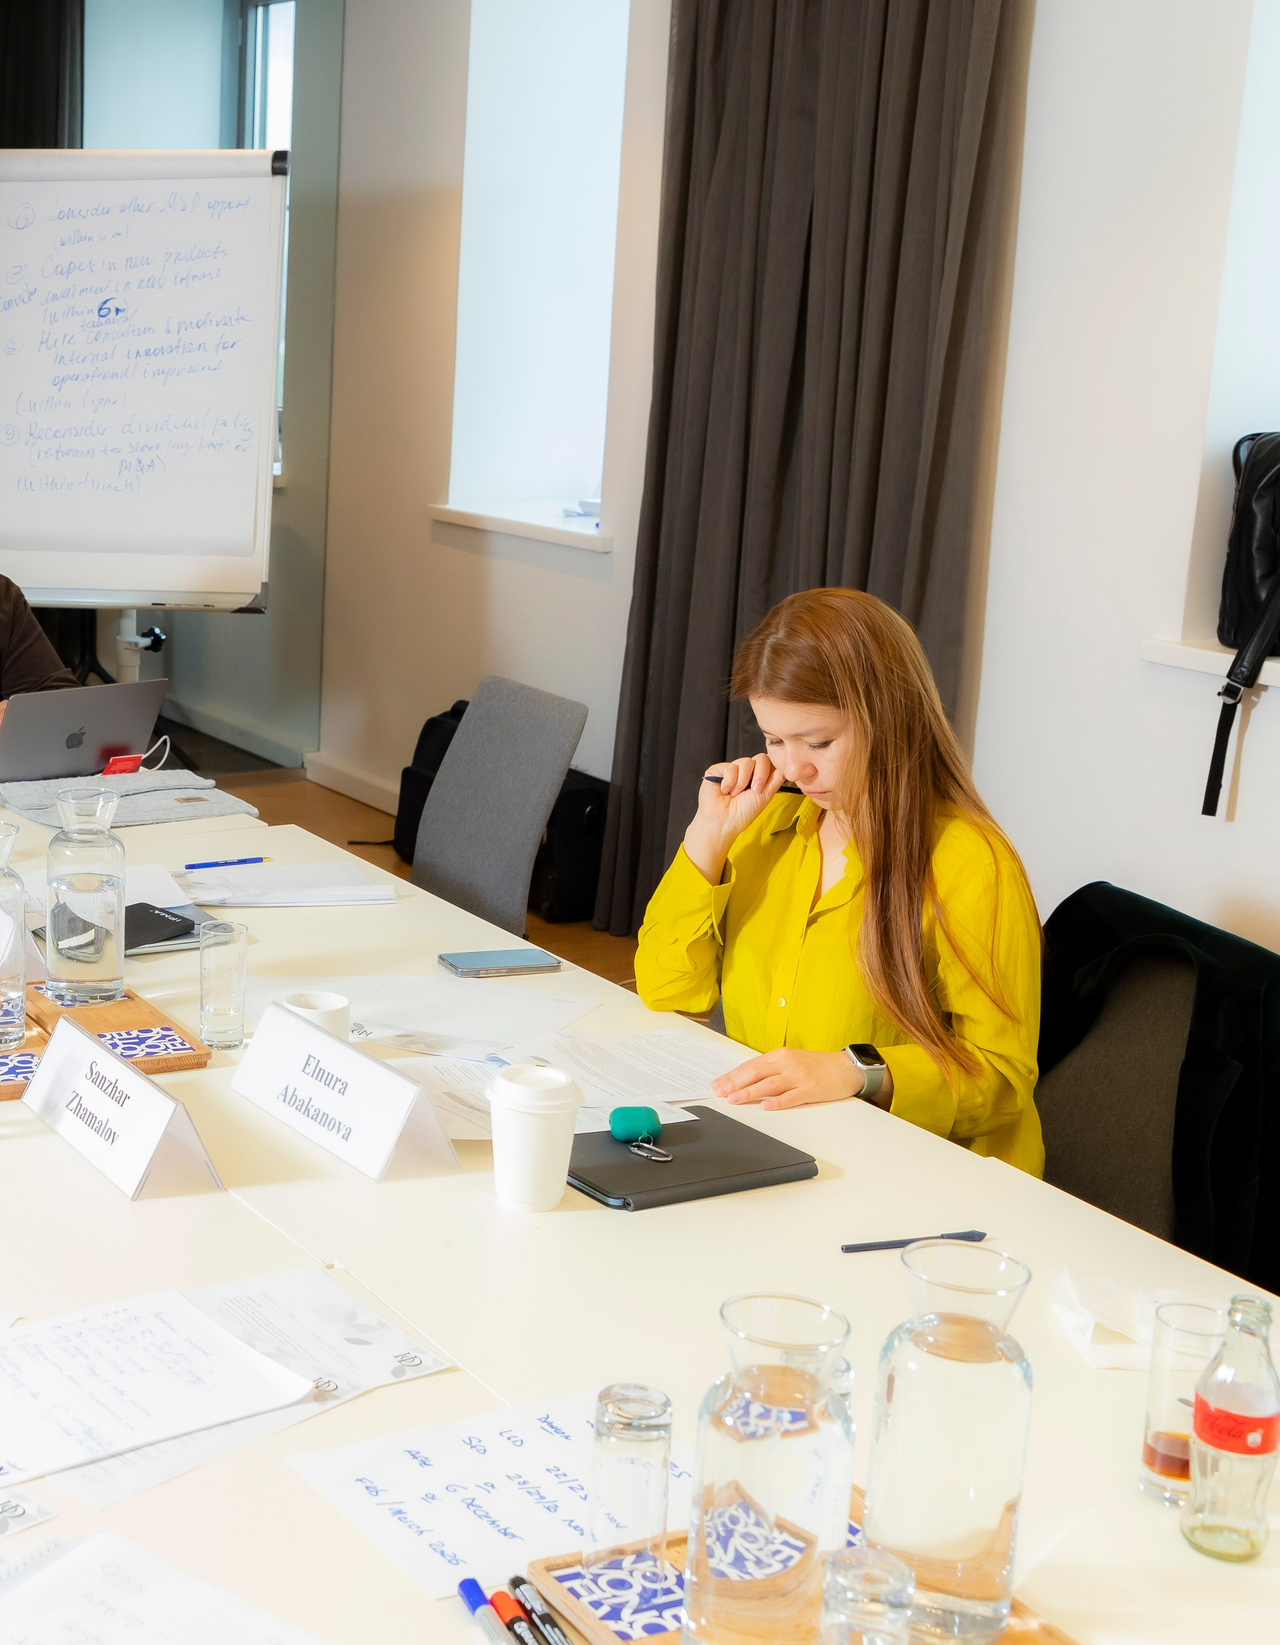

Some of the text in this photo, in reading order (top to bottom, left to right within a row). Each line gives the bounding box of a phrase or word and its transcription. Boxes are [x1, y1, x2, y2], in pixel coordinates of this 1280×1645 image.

[125, 255, 156, 270] new
[84, 1060, 131, 1109] Sanzhar
[301, 1053, 350, 1097] Elnura
[65, 1090, 119, 1147] Zhamalov
[276, 1084, 353, 1142] Abakanova
